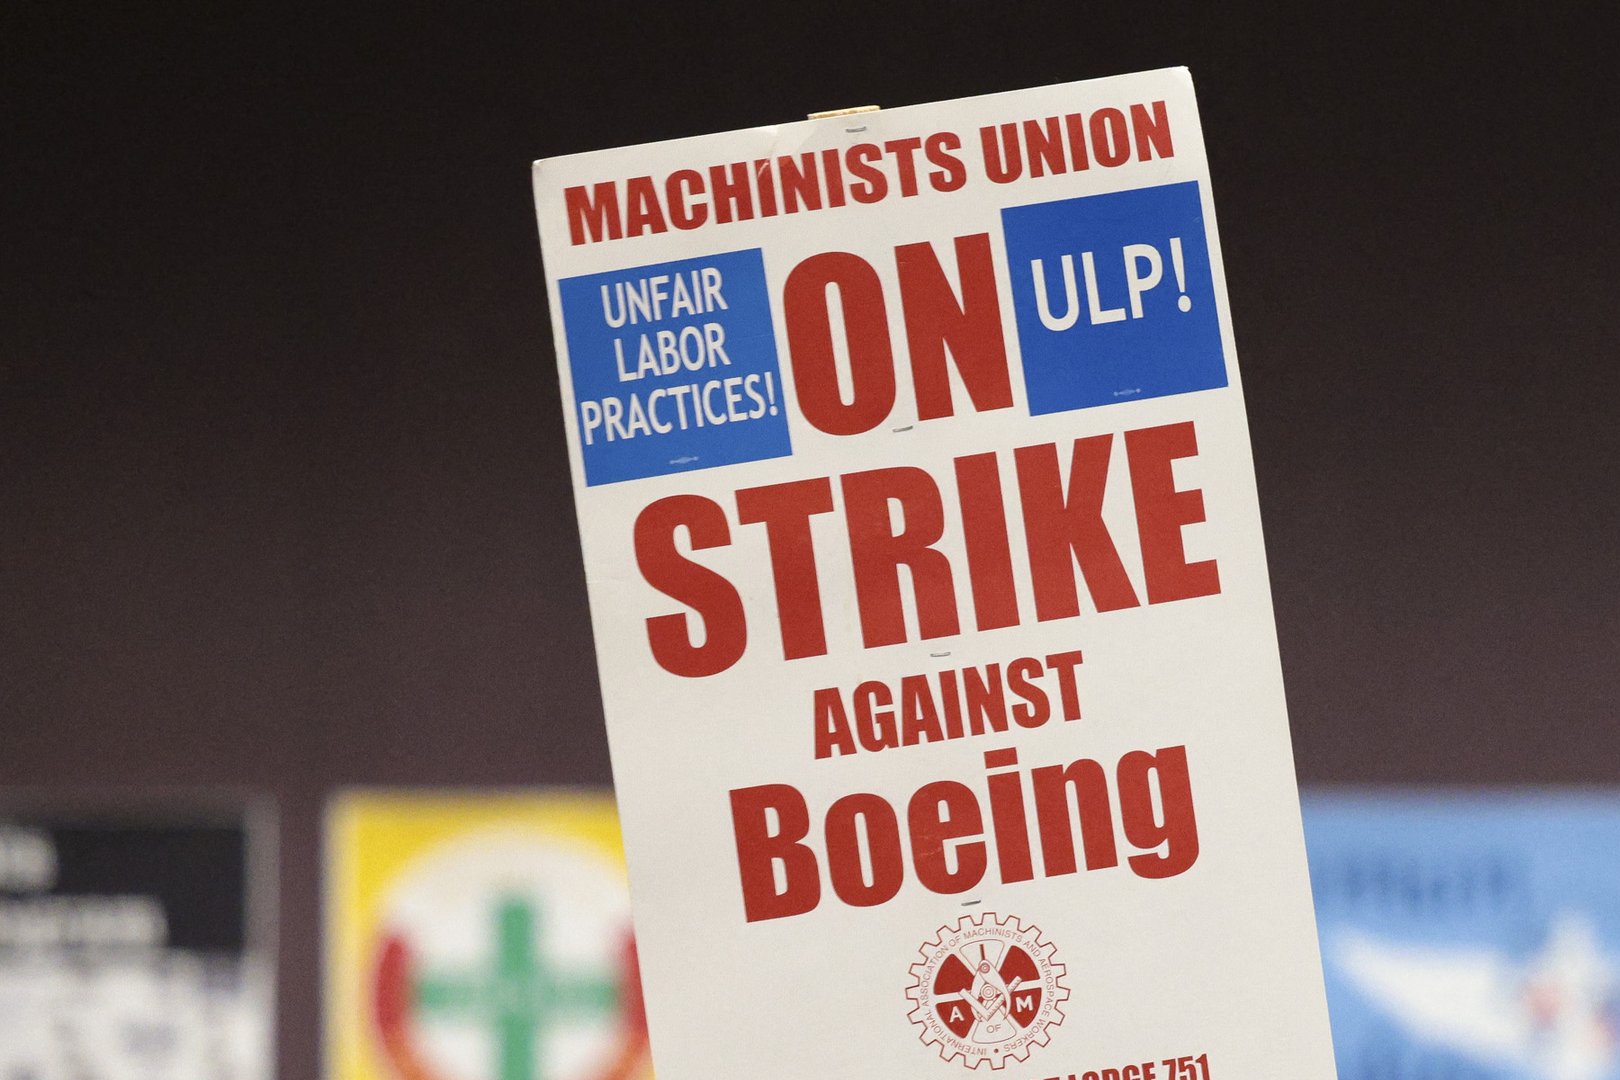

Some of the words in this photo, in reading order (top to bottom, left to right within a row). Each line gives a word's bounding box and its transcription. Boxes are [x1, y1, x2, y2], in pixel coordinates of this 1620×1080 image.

[563, 132, 967, 246] MACHINISTS
[980, 101, 1175, 184] UNION
[601, 267, 728, 328] UNFAIR
[1030, 237, 1192, 332] ULP!
[615, 330, 731, 382] LABOR
[783, 232, 1014, 436] ON
[581, 371, 779, 445] PRACTICES!
[633, 420, 1221, 678] STRIKE
[813, 650, 1084, 760] AGAINST
[728, 745, 1200, 923] Boeing
[948, 936, 961, 947] OF
[963, 928, 1023, 943] MACHINISTS
[1023, 941, 1041, 957] AND
[920, 945, 949, 1006] ASSOCIATION
[1039, 958, 1055, 1018] AEROSPACE
[924, 1011, 987, 1056] INTERNATIONAL
[950, 1006, 965, 1022] A
[1015, 995, 1034, 1013] M
[986, 1024, 1002, 1034] OF
[1003, 1020, 1047, 1052] WORKERS
